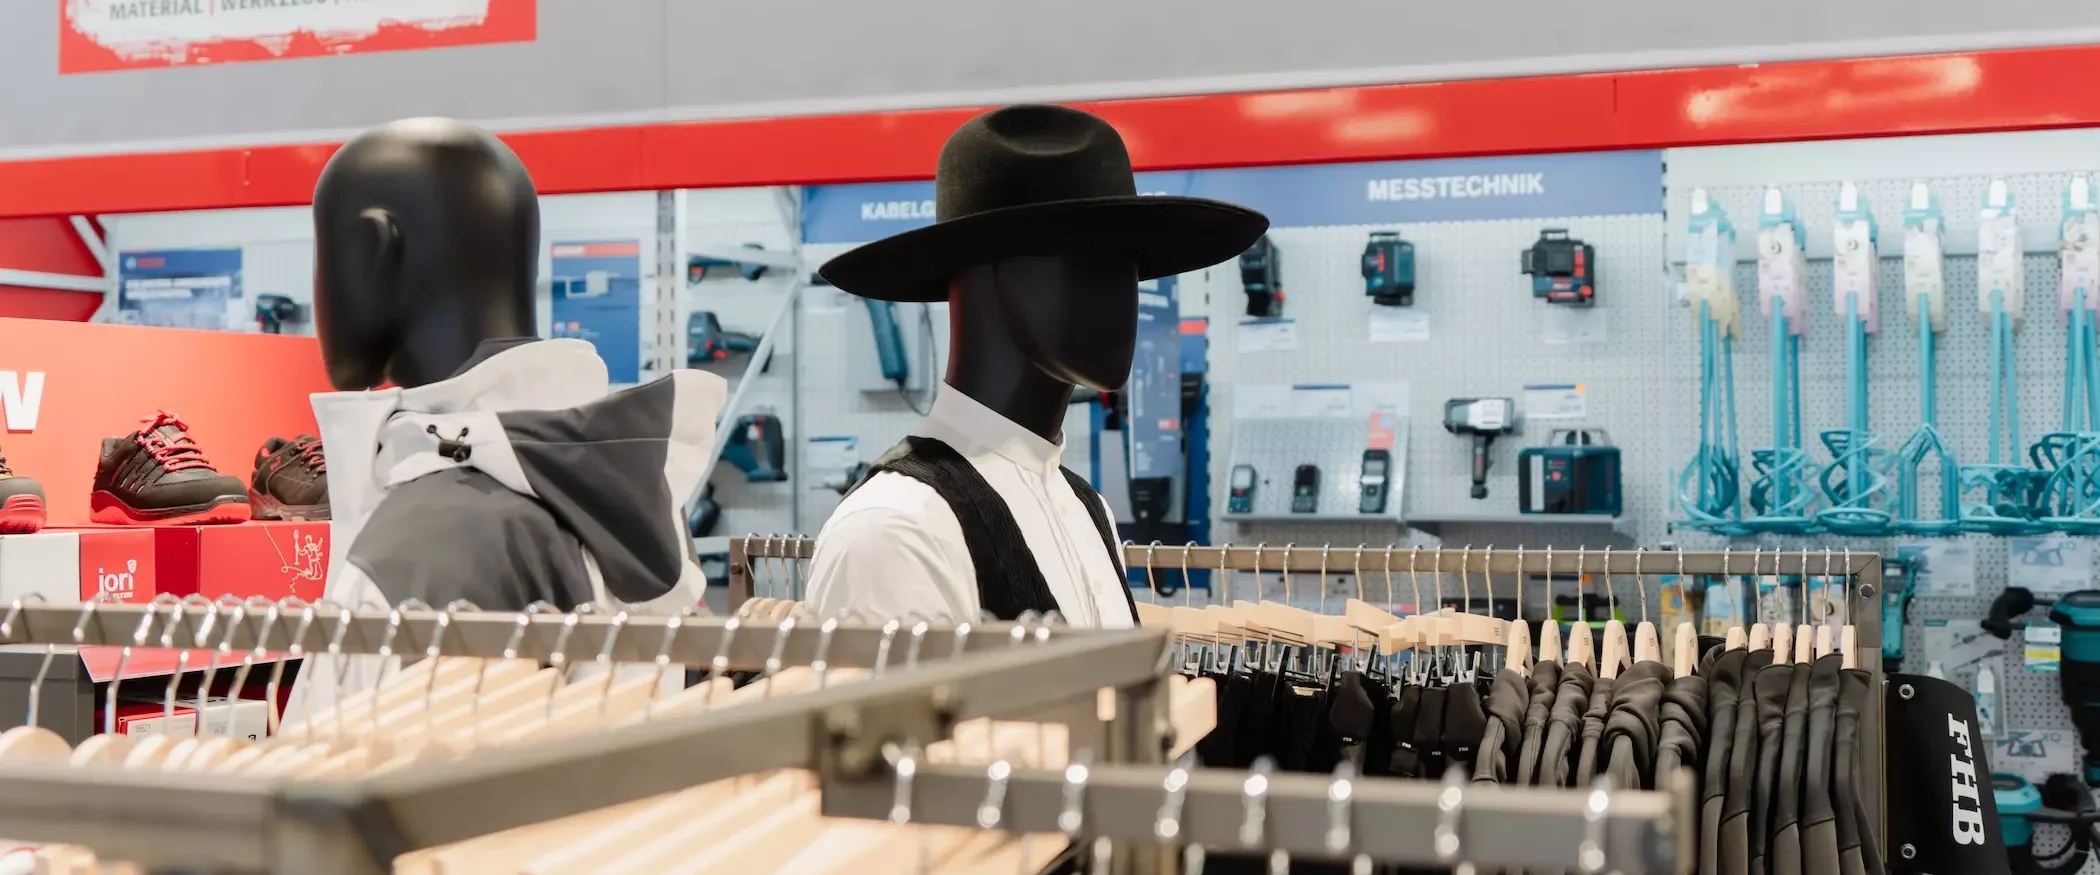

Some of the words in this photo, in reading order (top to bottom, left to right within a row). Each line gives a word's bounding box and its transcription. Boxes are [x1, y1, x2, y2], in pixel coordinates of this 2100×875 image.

[109, 0, 203, 20] MATERIAL
[1368, 172, 1545, 201] MESSTECHNIK
[861, 200, 937, 220] KABELG
[1947, 712, 1985, 846] FHB
